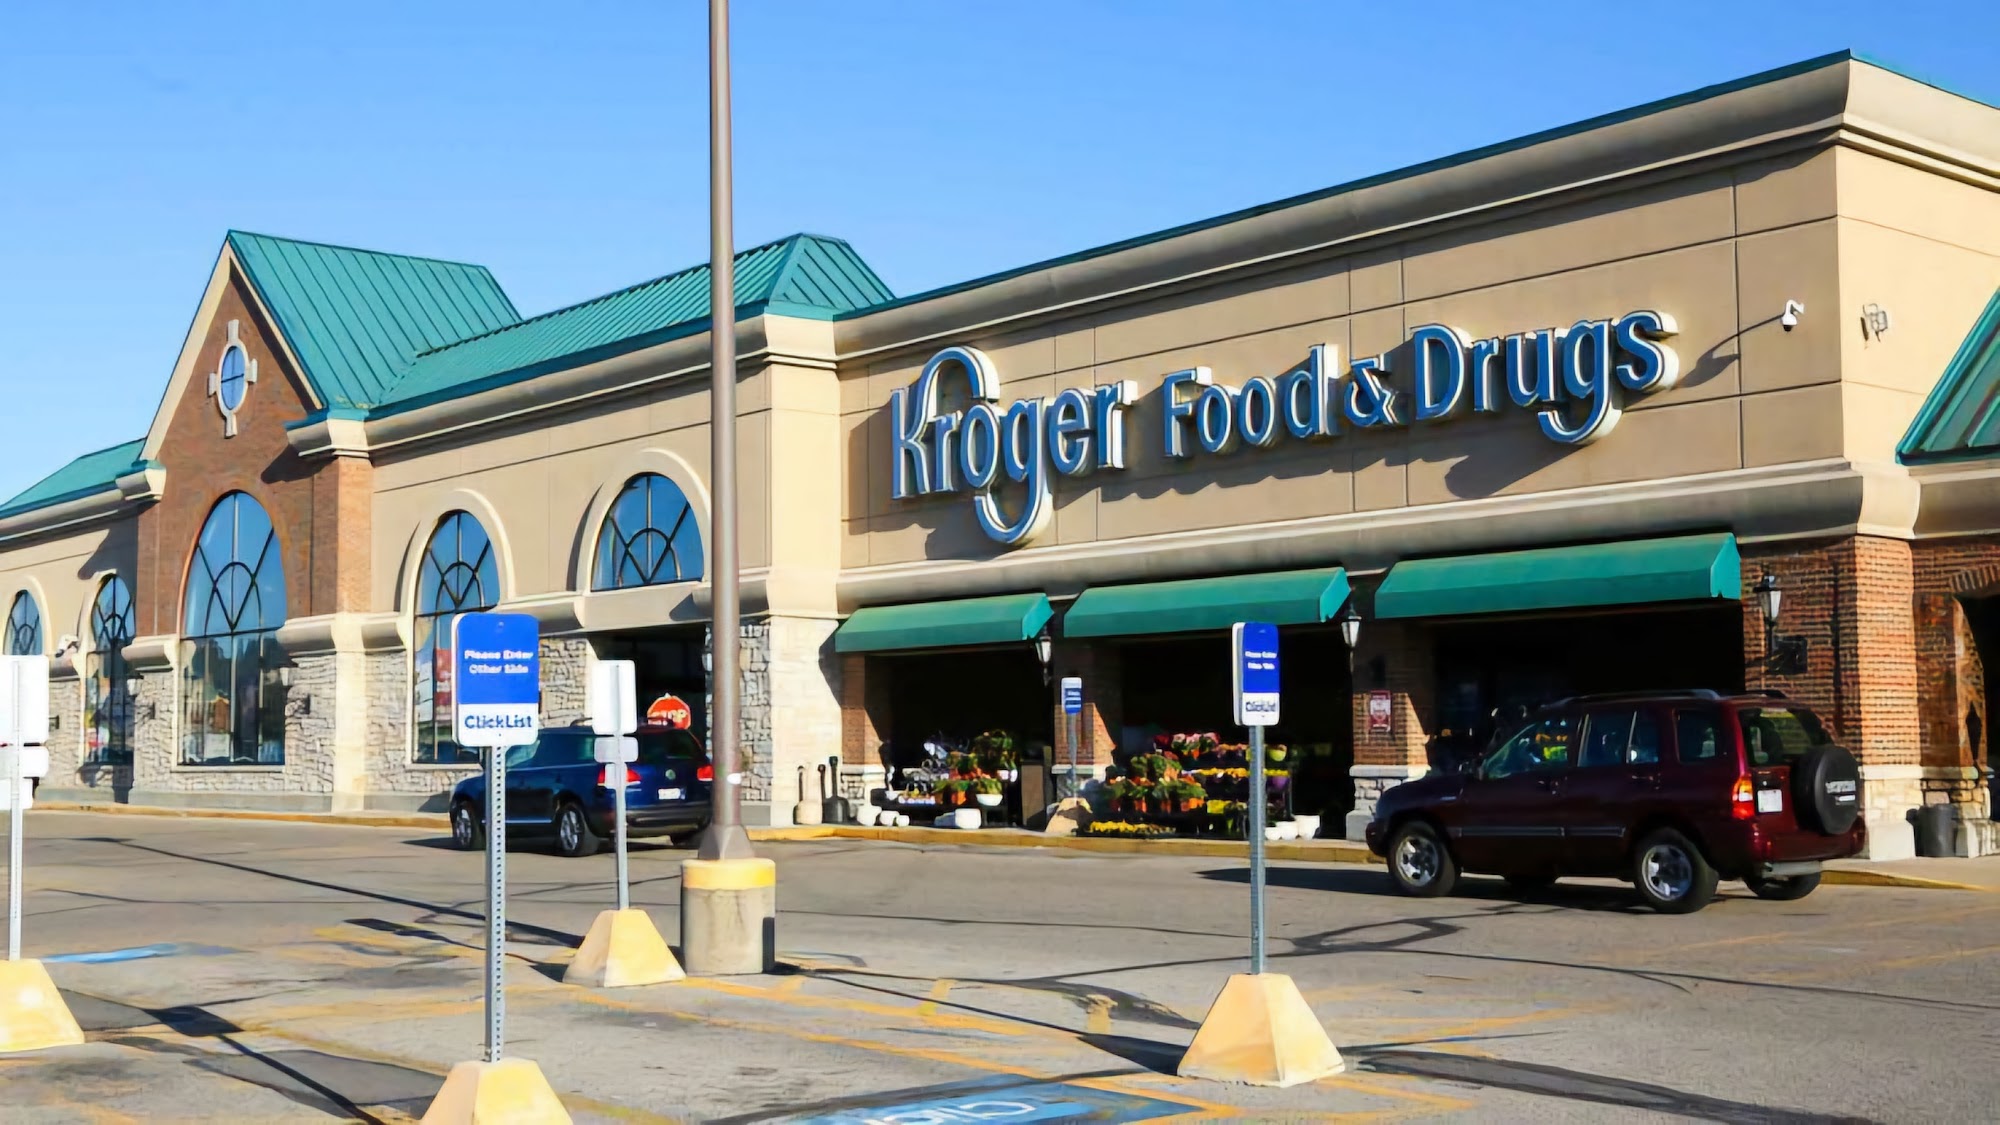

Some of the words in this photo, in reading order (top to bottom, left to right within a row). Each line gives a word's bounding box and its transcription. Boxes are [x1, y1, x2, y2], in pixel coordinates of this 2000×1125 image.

[891, 346, 1136, 544] Kroger
[1161, 345, 1337, 456] Food
[1344, 355, 1399, 427] &
[1411, 310, 1678, 444] Drugs
[464, 714, 532, 729] ClickList
